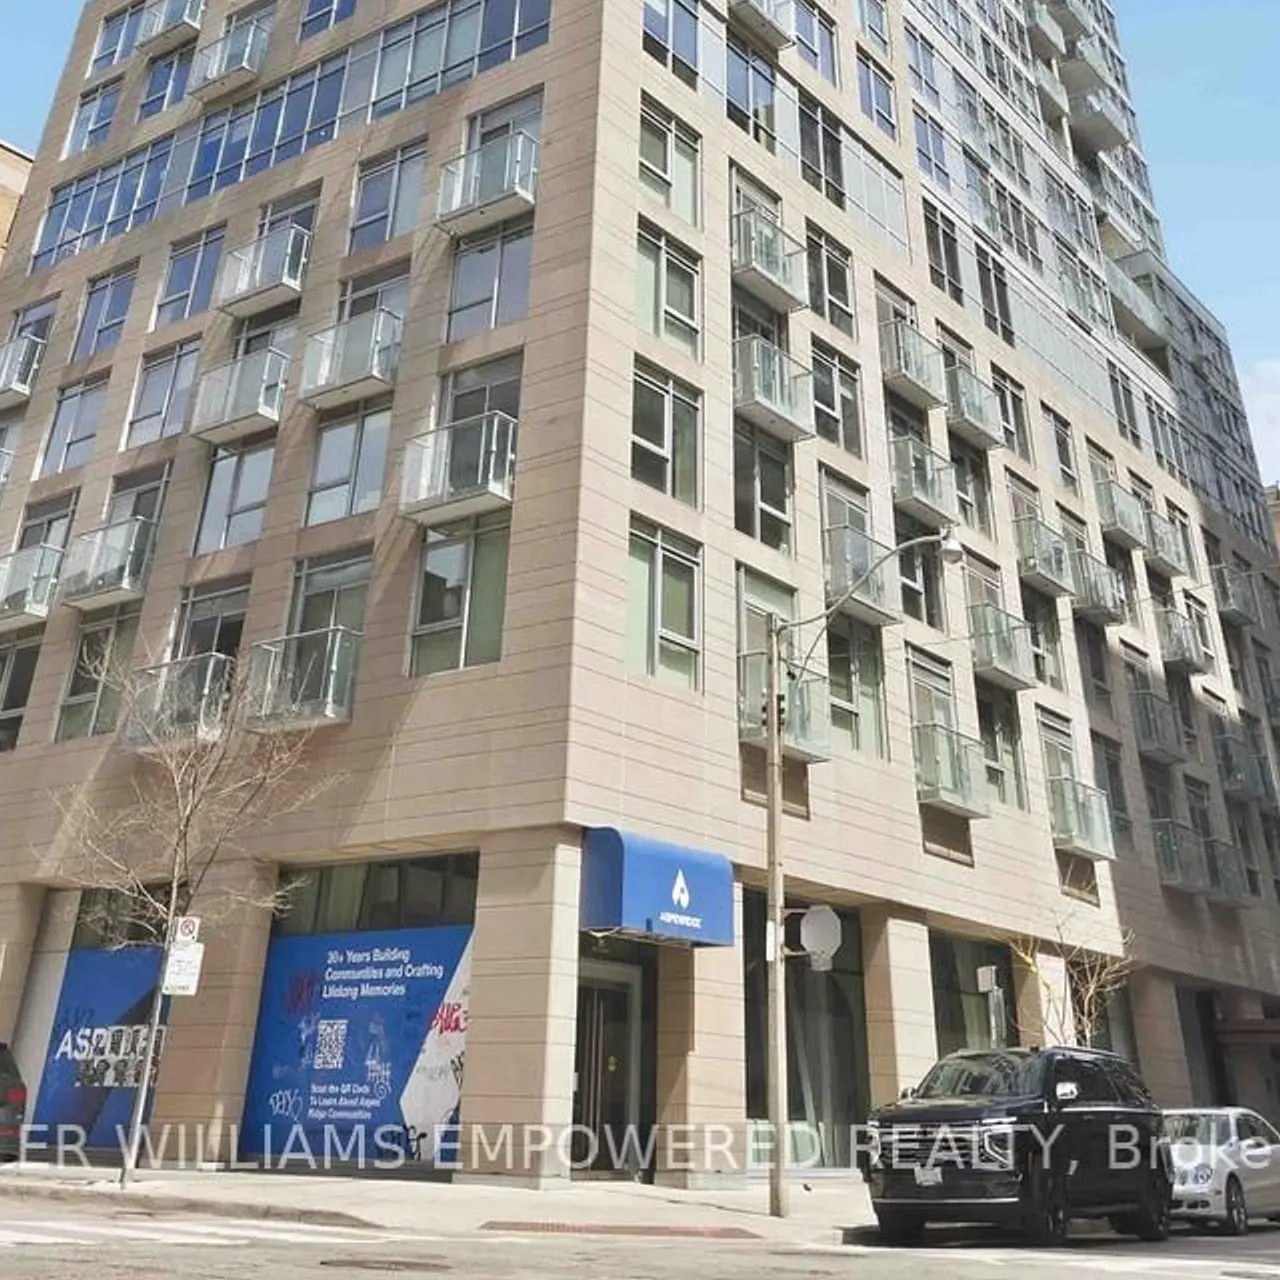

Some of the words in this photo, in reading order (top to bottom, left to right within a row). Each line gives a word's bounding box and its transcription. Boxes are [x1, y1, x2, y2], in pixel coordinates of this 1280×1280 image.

[345, 949, 371, 964] Years
[372, 948, 411, 963] Building
[325, 967, 383, 981] Communities
[384, 965, 403, 978] and
[404, 963, 444, 979] Crafting
[322, 983, 359, 1000] Lifelong
[360, 982, 406, 997] Memories
